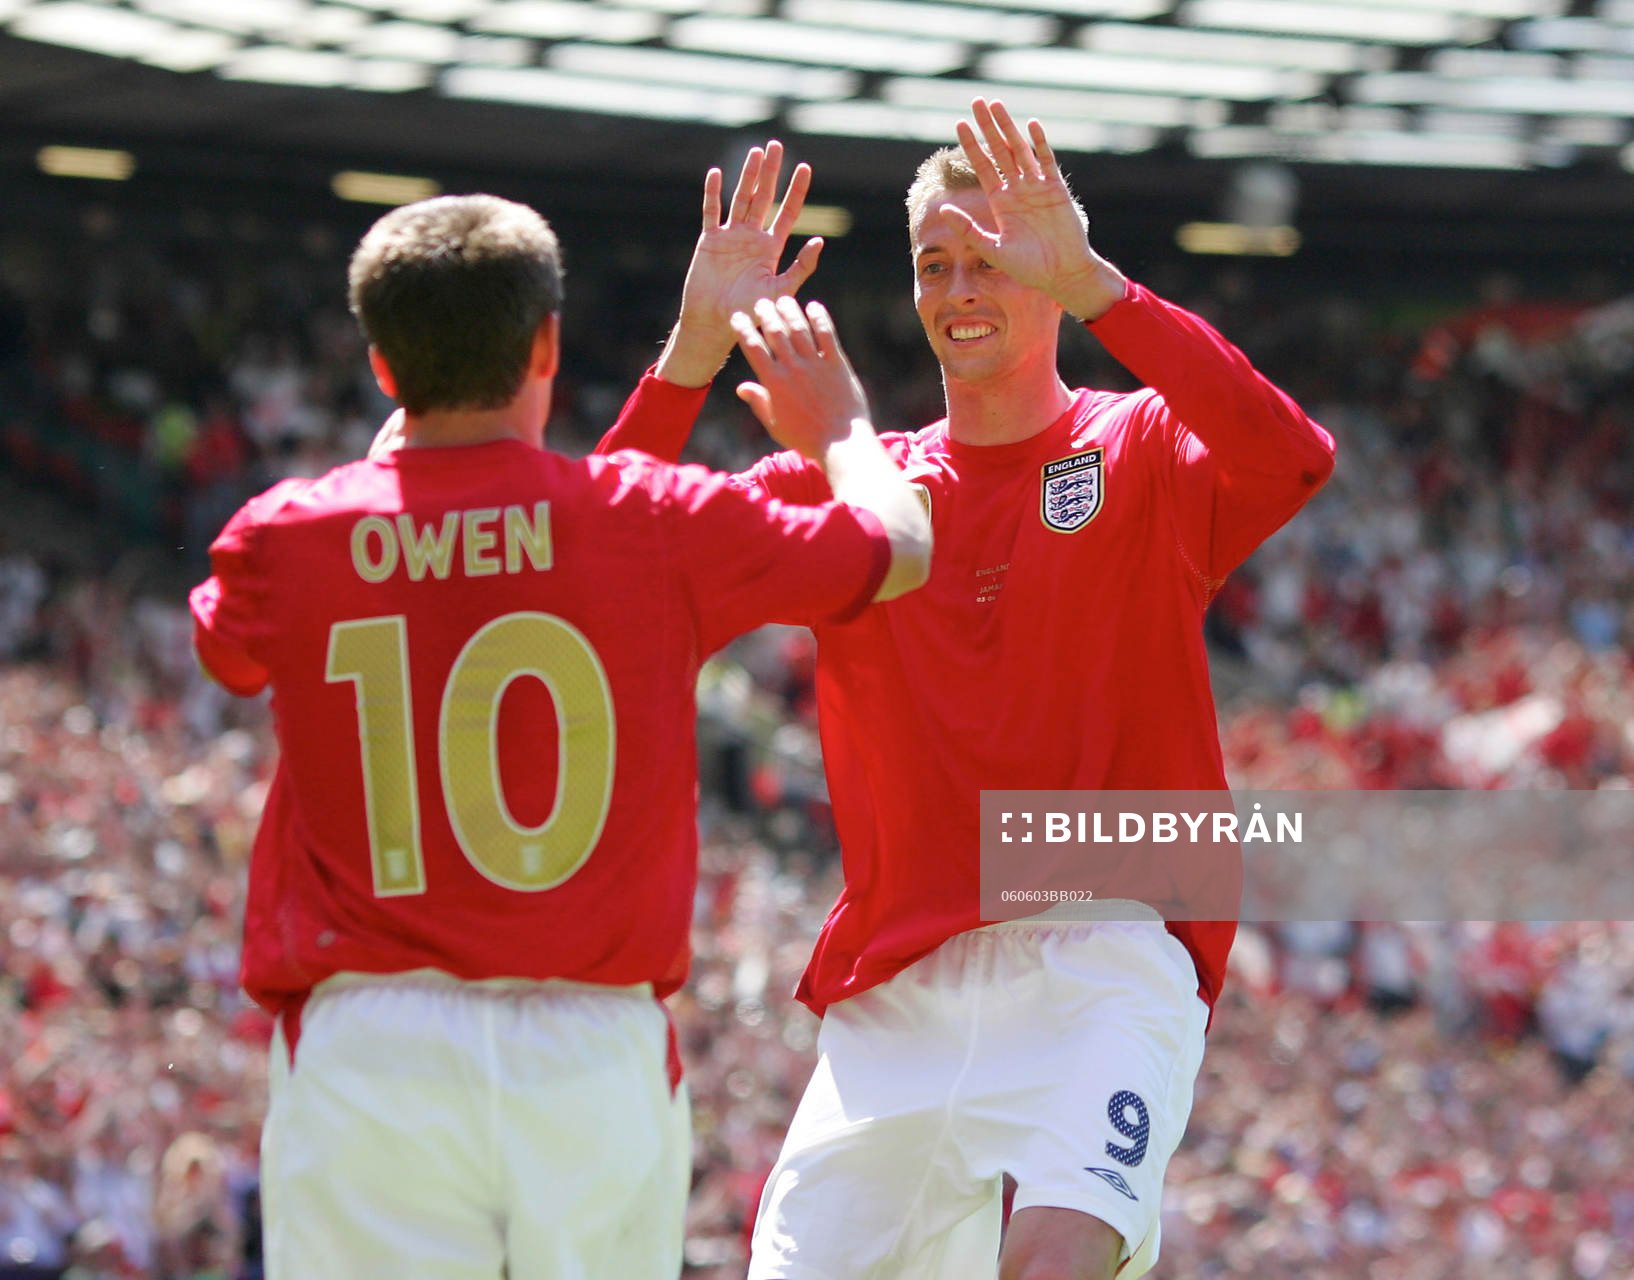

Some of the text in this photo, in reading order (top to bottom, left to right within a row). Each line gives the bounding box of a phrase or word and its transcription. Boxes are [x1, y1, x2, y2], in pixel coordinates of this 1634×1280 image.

[1047, 454, 1097, 474] ENGLAND
[350, 501, 553, 583] OWEN
[325, 611, 616, 898] 10
[1105, 1090, 1150, 1168] 9
